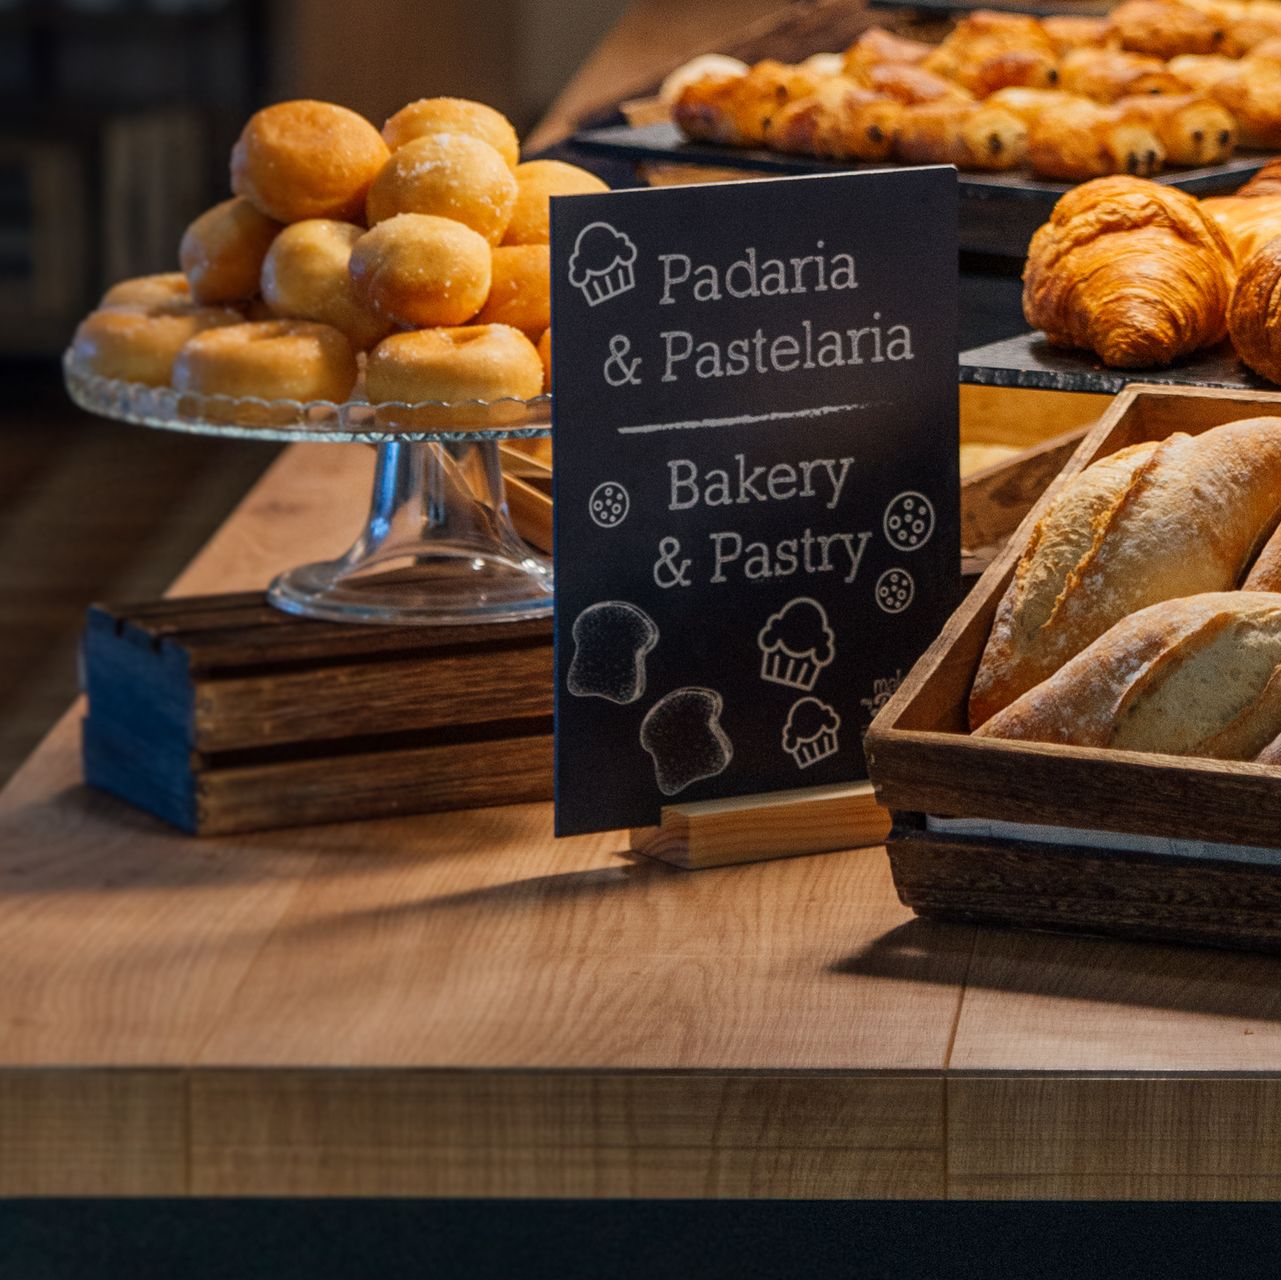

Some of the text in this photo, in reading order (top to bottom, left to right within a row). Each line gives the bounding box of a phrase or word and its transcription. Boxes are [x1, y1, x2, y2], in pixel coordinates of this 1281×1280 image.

[657, 240, 859, 305] Padaria
[603, 311, 915, 387] & Pastelaria
[667, 453, 855, 511] Bakery
[653, 527, 872, 589] & Pastry
